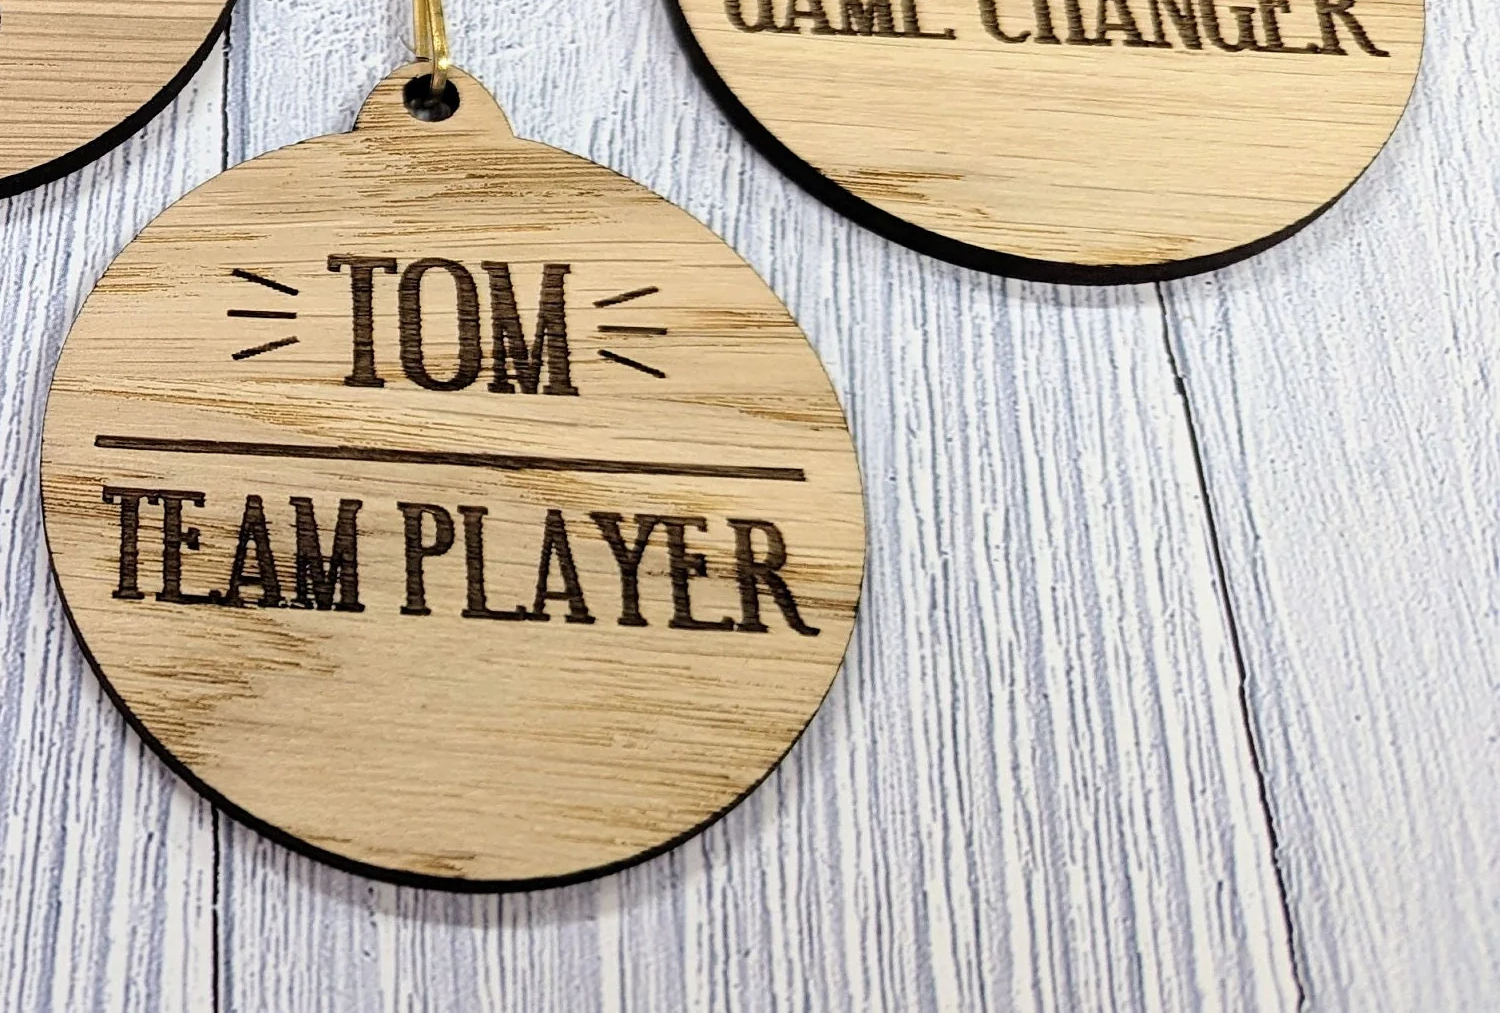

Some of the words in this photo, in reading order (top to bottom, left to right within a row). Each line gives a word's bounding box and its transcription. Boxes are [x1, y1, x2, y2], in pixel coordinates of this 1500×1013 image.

[327, 255, 580, 396] TOM
[99, 484, 365, 612] TEAM
[397, 502, 820, 636] PLAYER
